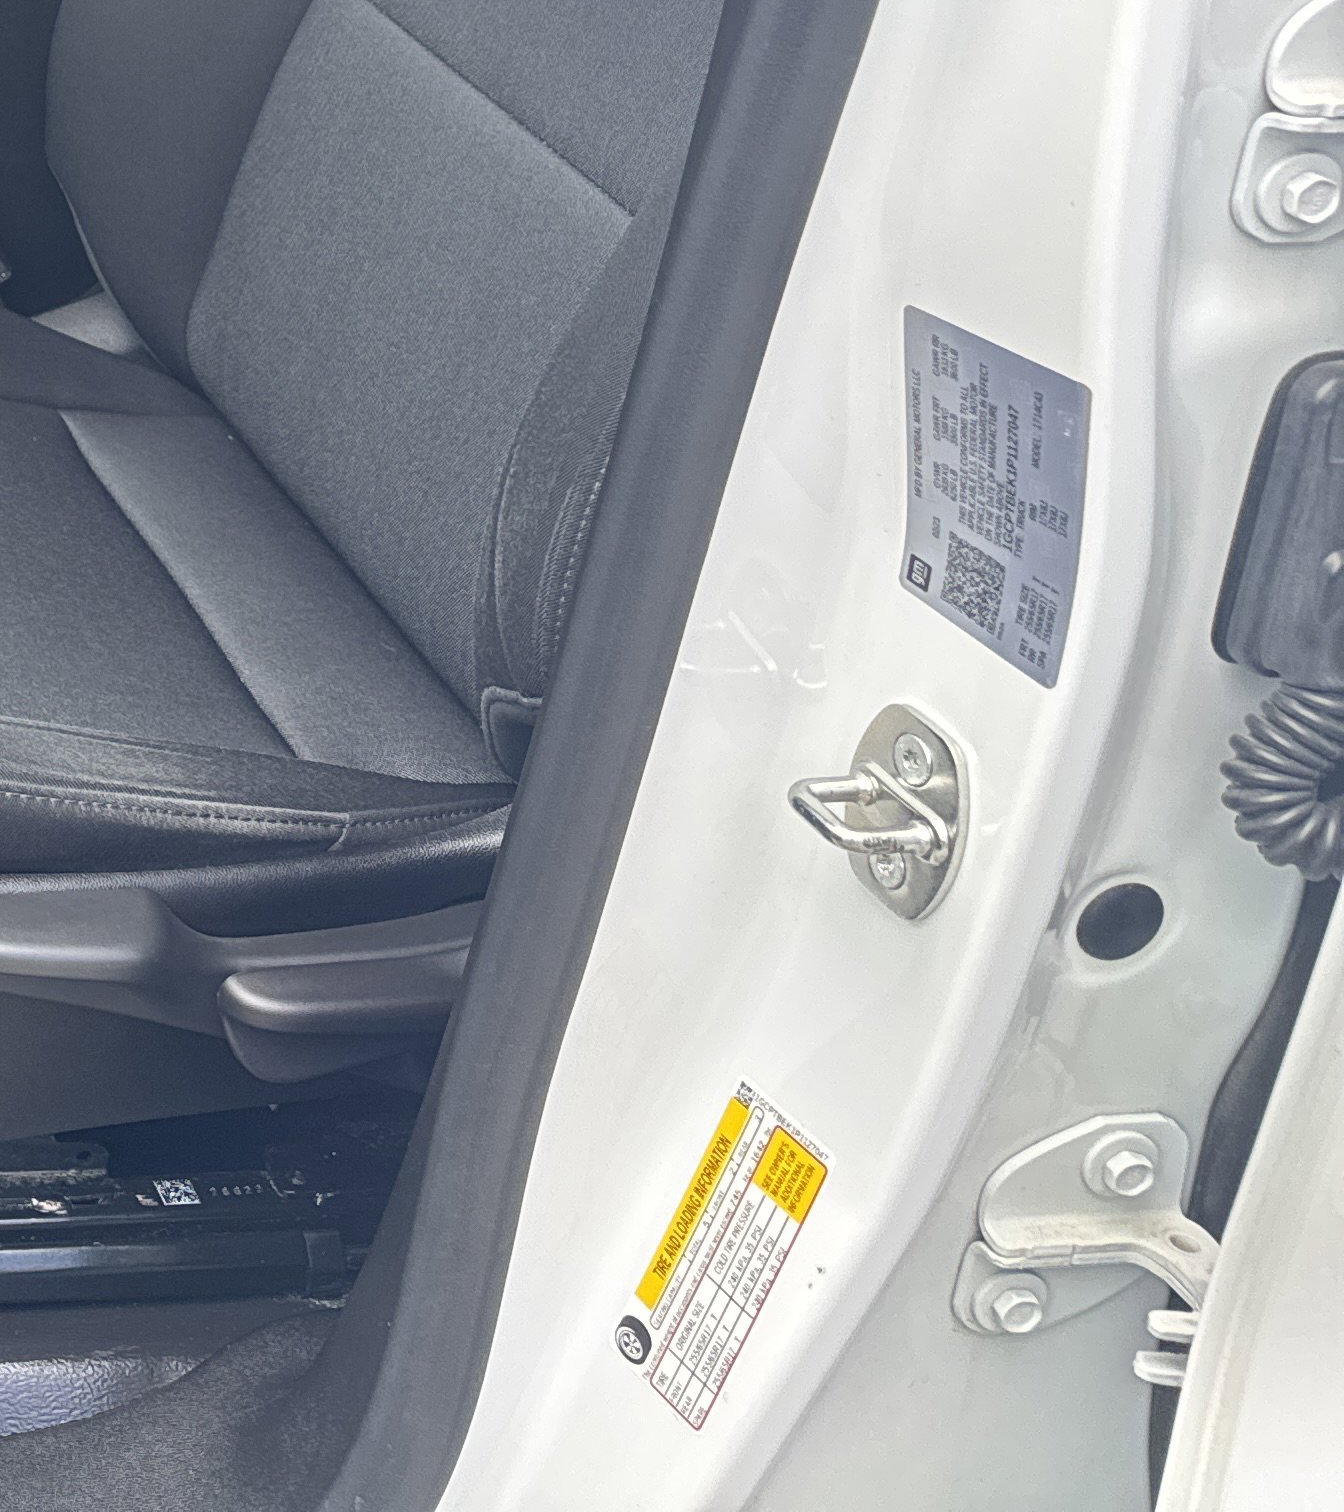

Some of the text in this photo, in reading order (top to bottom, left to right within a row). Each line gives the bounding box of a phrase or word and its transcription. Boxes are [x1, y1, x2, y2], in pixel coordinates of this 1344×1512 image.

[932, 333, 939, 348] RR
[940, 342, 948, 356] KG
[950, 348, 958, 361] LB
[912, 367, 920, 387] LLC
[978, 362, 988, 398] EFFECT
[912, 387, 921, 424] MOTORS
[941, 406, 948, 421] KG
[960, 403, 967, 415] TO
[969, 382, 977, 416] MOTOR
[979, 398, 986, 408] IN
[950, 412, 957, 425] LB
[960, 417, 968, 466] CONFORMS
[969, 418, 977, 458] FEDERAL
[914, 465, 922, 479] BY
[950, 468, 957, 482] LB
[959, 467, 967, 505] VEHICLE
[984, 402, 997, 542] ON THE DATE OF MANUFACTURE
[1002, 404, 1018, 553] 1GCPTBEK1P1127047
[994, 513, 1002, 547] SHOWN
[1016, 498, 1025, 530] TRUCK
[911, 558, 927, 588] gm
[1015, 604, 1025, 627] TIRE
[761, 1140, 789, 1190] SEE OWNER'S
[770, 1149, 797, 1197] MANUAL FOR
[779, 1160, 805, 1203] ADDITIONAL
[786, 1163, 816, 1214] INFORMATION
[652, 1133, 732, 1281] TIRE AND LOADING INFORMATION
[774, 1247, 786, 1263] PSI
[655, 1200, 755, 1389] TIRE ORIGINAL SIZE COLD TIRE PRESSURE
[688, 1324, 712, 1365] 255/65R17
[710, 1313, 718, 1321] T
[727, 1271, 739, 1288] 240
[744, 1241, 754, 1253] 35
[750, 1224, 762, 1241] PSI
[700, 1335, 725, 1376] 255/65R17
[739, 1282, 752, 1300] 240
[756, 1252, 766, 1264] 35
[762, 1236, 775, 1252] PSI
